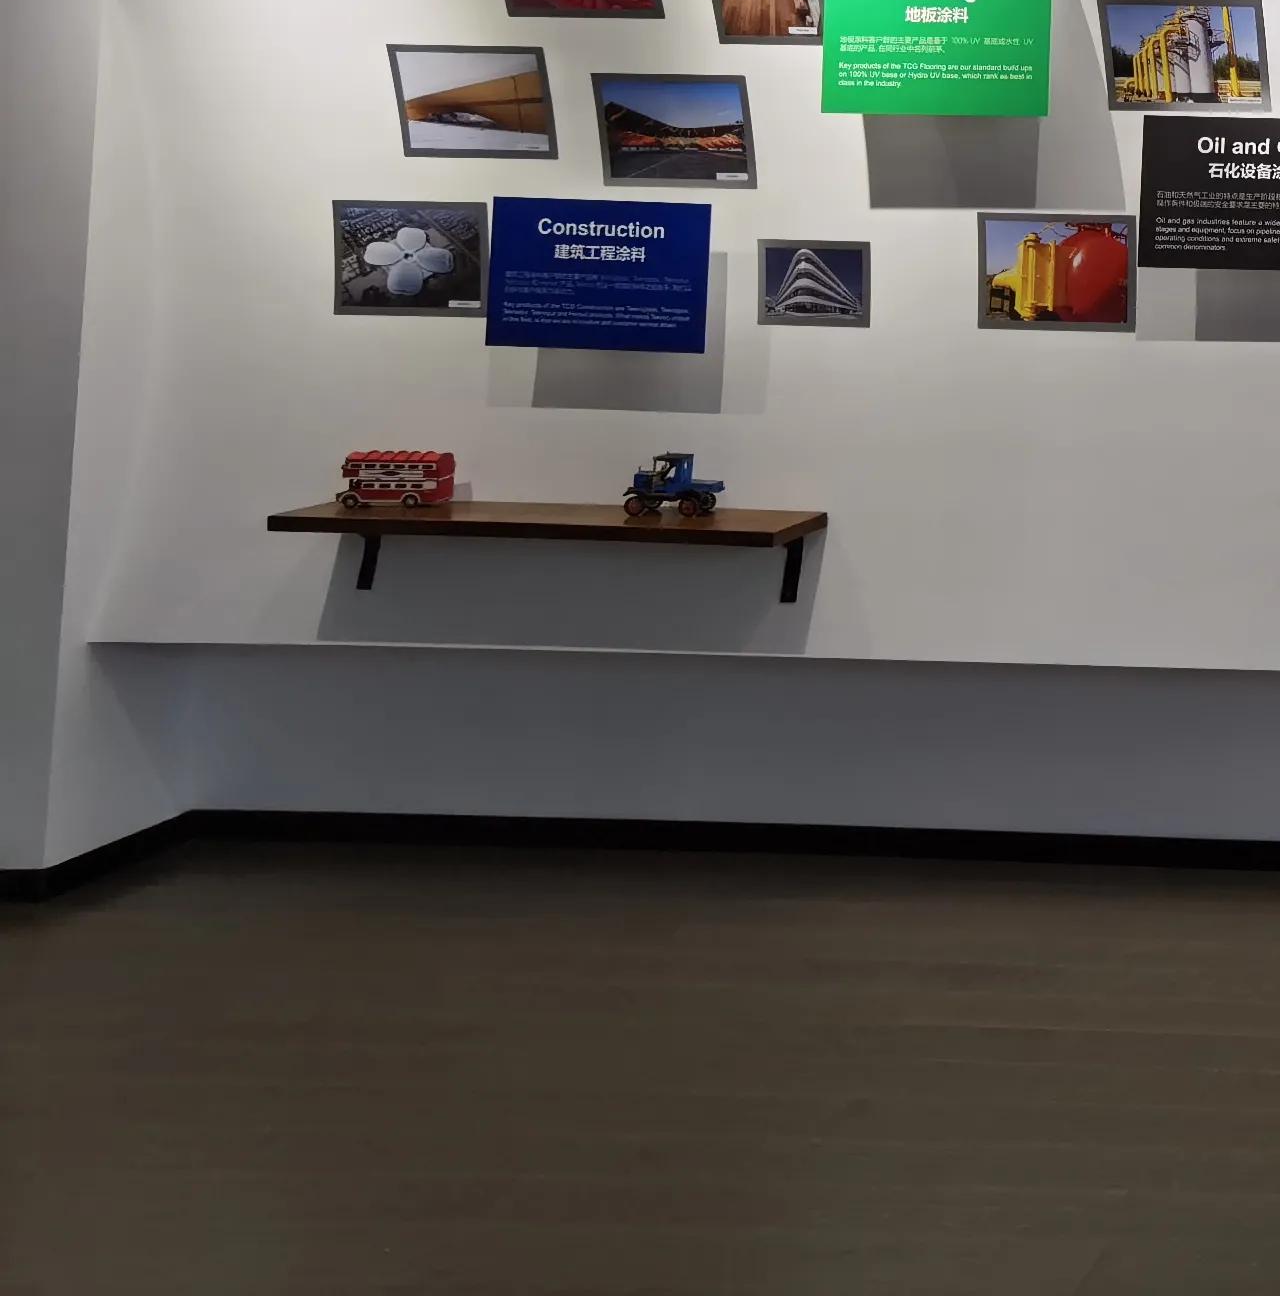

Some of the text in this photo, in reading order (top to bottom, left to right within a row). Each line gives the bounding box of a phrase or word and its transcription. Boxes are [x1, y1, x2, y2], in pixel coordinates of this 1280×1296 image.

[904, 5, 969, 23] 地板涂料
[1196, 135, 1225, 154] Oil
[1231, 136, 1270, 155] and
[536, 217, 665, 239] Construction
[553, 242, 646, 262] 建筑工程涂料
